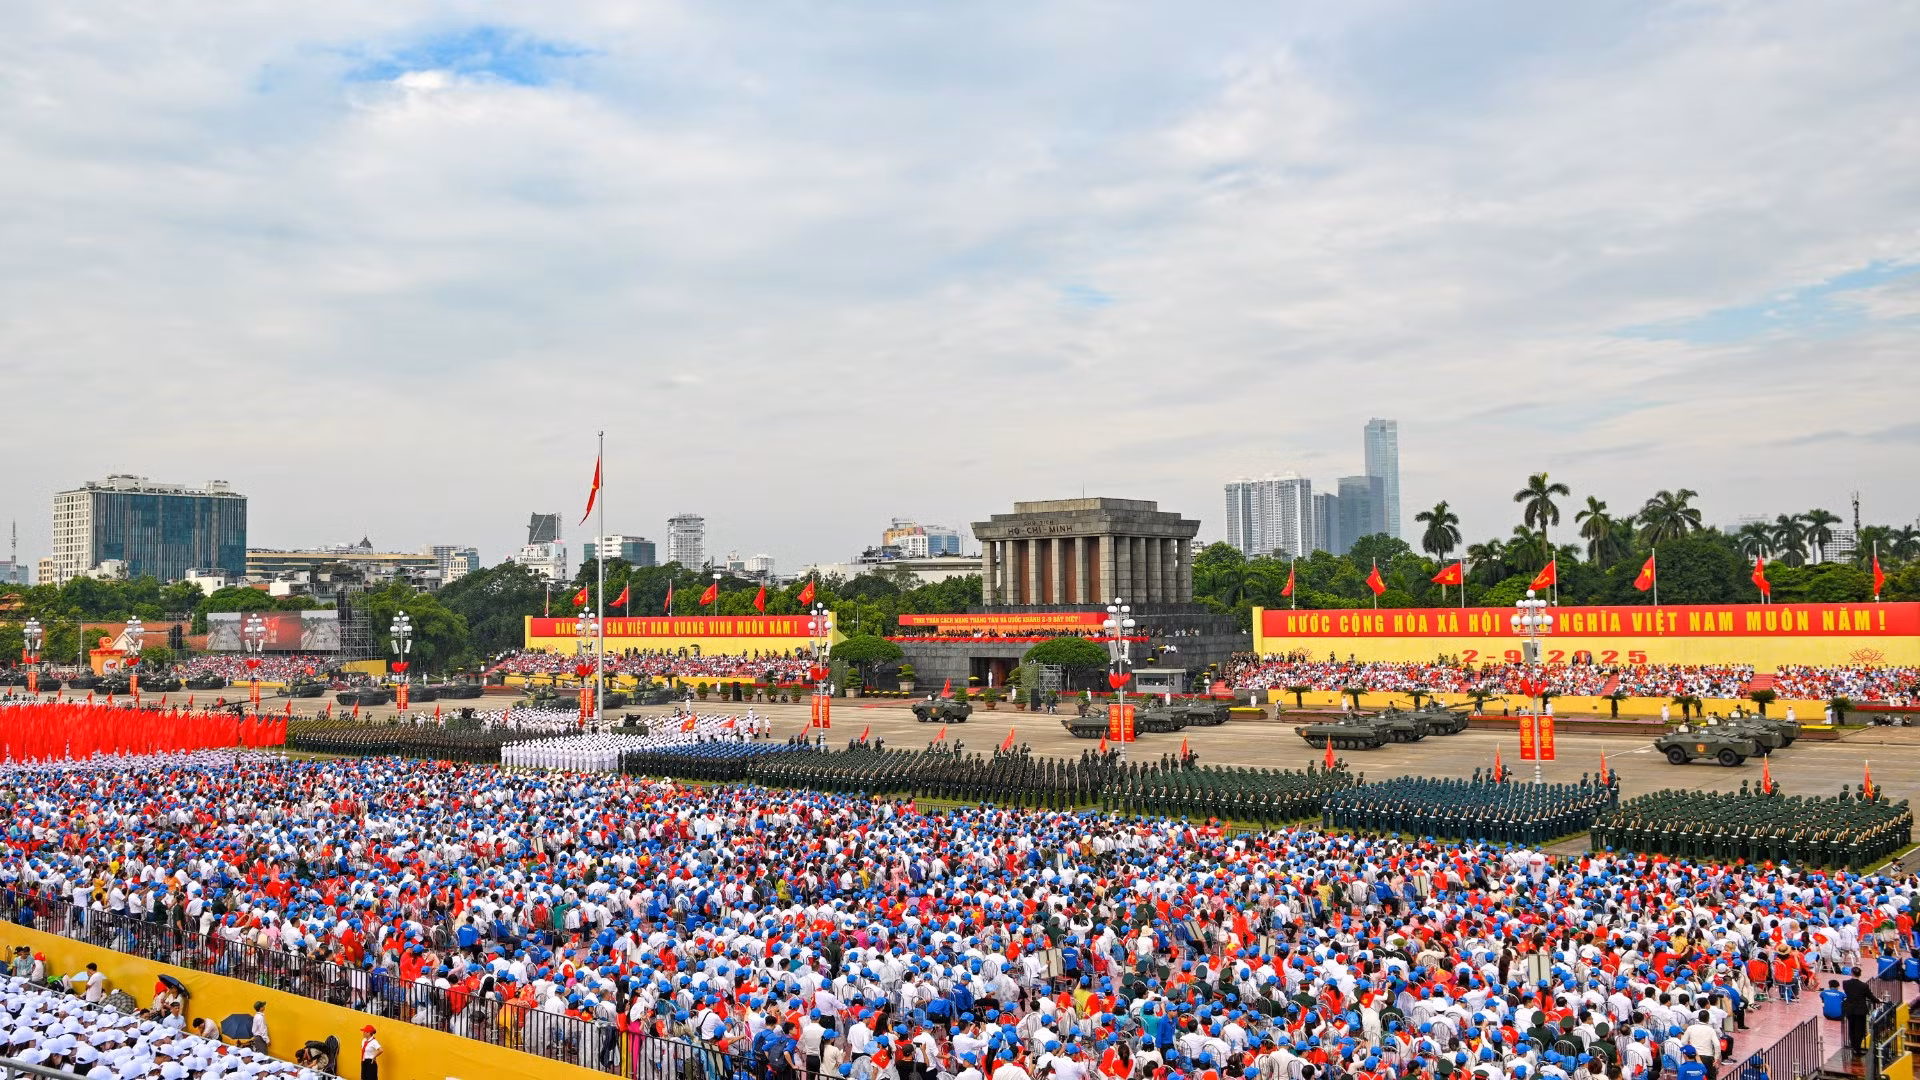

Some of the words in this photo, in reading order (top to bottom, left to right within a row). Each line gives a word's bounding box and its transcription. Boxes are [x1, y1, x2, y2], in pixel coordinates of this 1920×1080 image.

[606, 619, 623, 634] SẢN
[627, 619, 646, 636] VIỆT
[650, 621, 670, 634] NAM
[674, 621, 704, 636] QUANG
[709, 621, 732, 634] VINH
[737, 618, 765, 635] MUÔN
[770, 618, 791, 635] NĂM
[1288, 612, 1330, 634] NƯỚC
[1340, 612, 1384, 636] CỘNG
[1394, 612, 1428, 633] HÒA
[1438, 612, 1459, 632] XÃ
[1469, 610, 1500, 636] HỘI
[1560, 610, 1621, 632] NGHĨA
[1632, 608, 1678, 635] VIỆT
[1690, 612, 1734, 632] NAM
[1747, 608, 1810, 632] MUÔN
[1822, 607, 1871, 632] NĂM
